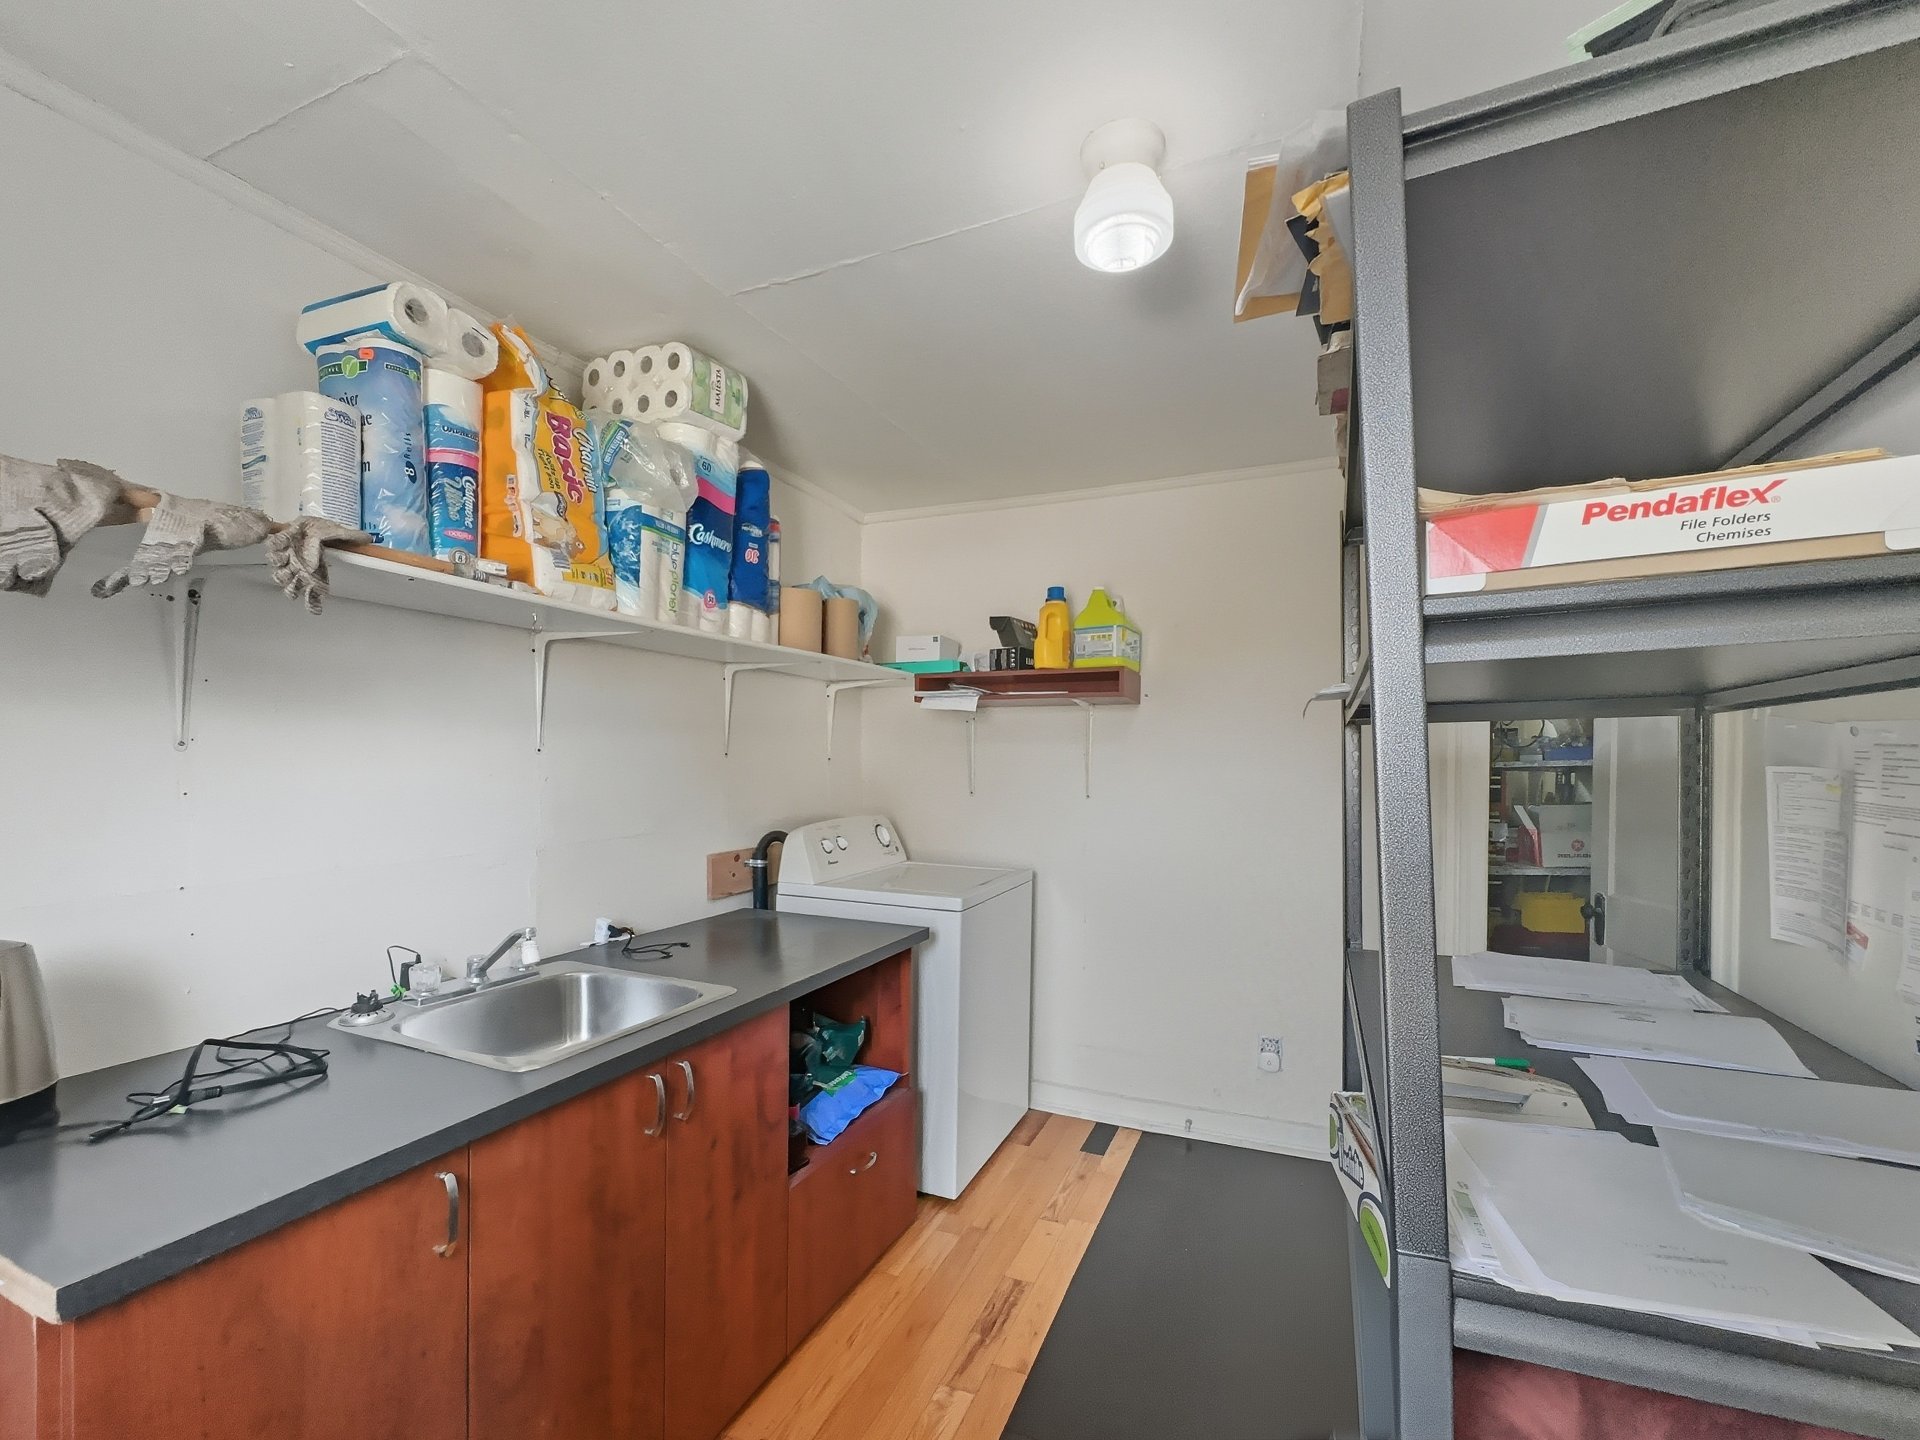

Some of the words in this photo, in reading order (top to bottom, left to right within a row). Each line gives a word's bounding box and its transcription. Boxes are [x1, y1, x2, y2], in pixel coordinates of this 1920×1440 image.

[545, 411, 584, 505] Basic
[572, 426, 598, 493] Charmin
[1581, 478, 1788, 526] Pendaflex
[689, 523, 732, 554] Cashmere
[1680, 518, 1707, 531] File
[1712, 512, 1771, 528] Folders
[1696, 527, 1771, 543] Chemises
[671, 542, 681, 570] blue
[669, 570, 680, 612] planet
